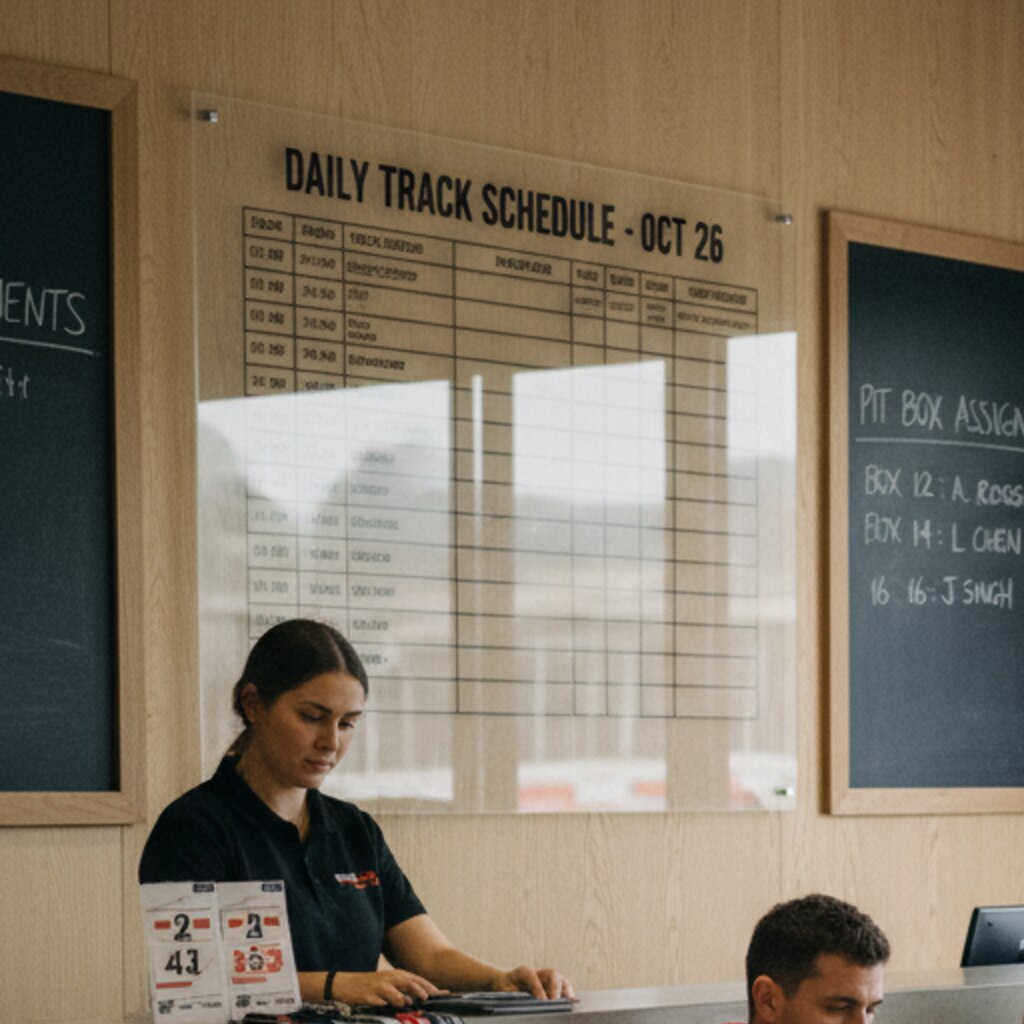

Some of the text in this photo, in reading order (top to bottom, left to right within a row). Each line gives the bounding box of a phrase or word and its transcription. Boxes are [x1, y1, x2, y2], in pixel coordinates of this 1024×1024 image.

[285, 147, 370, 203] DAILY
[378, 163, 473, 223] TRACK
[481, 182, 616, 248] SCHEDULE
[640, 211, 688, 258] OCT
[693, 220, 724, 265] 26
[859, 383, 892, 425] PIT
[901, 389, 943, 431] BOX
[864, 463, 904, 497] BOX
[864, 511, 903, 545] BOX
